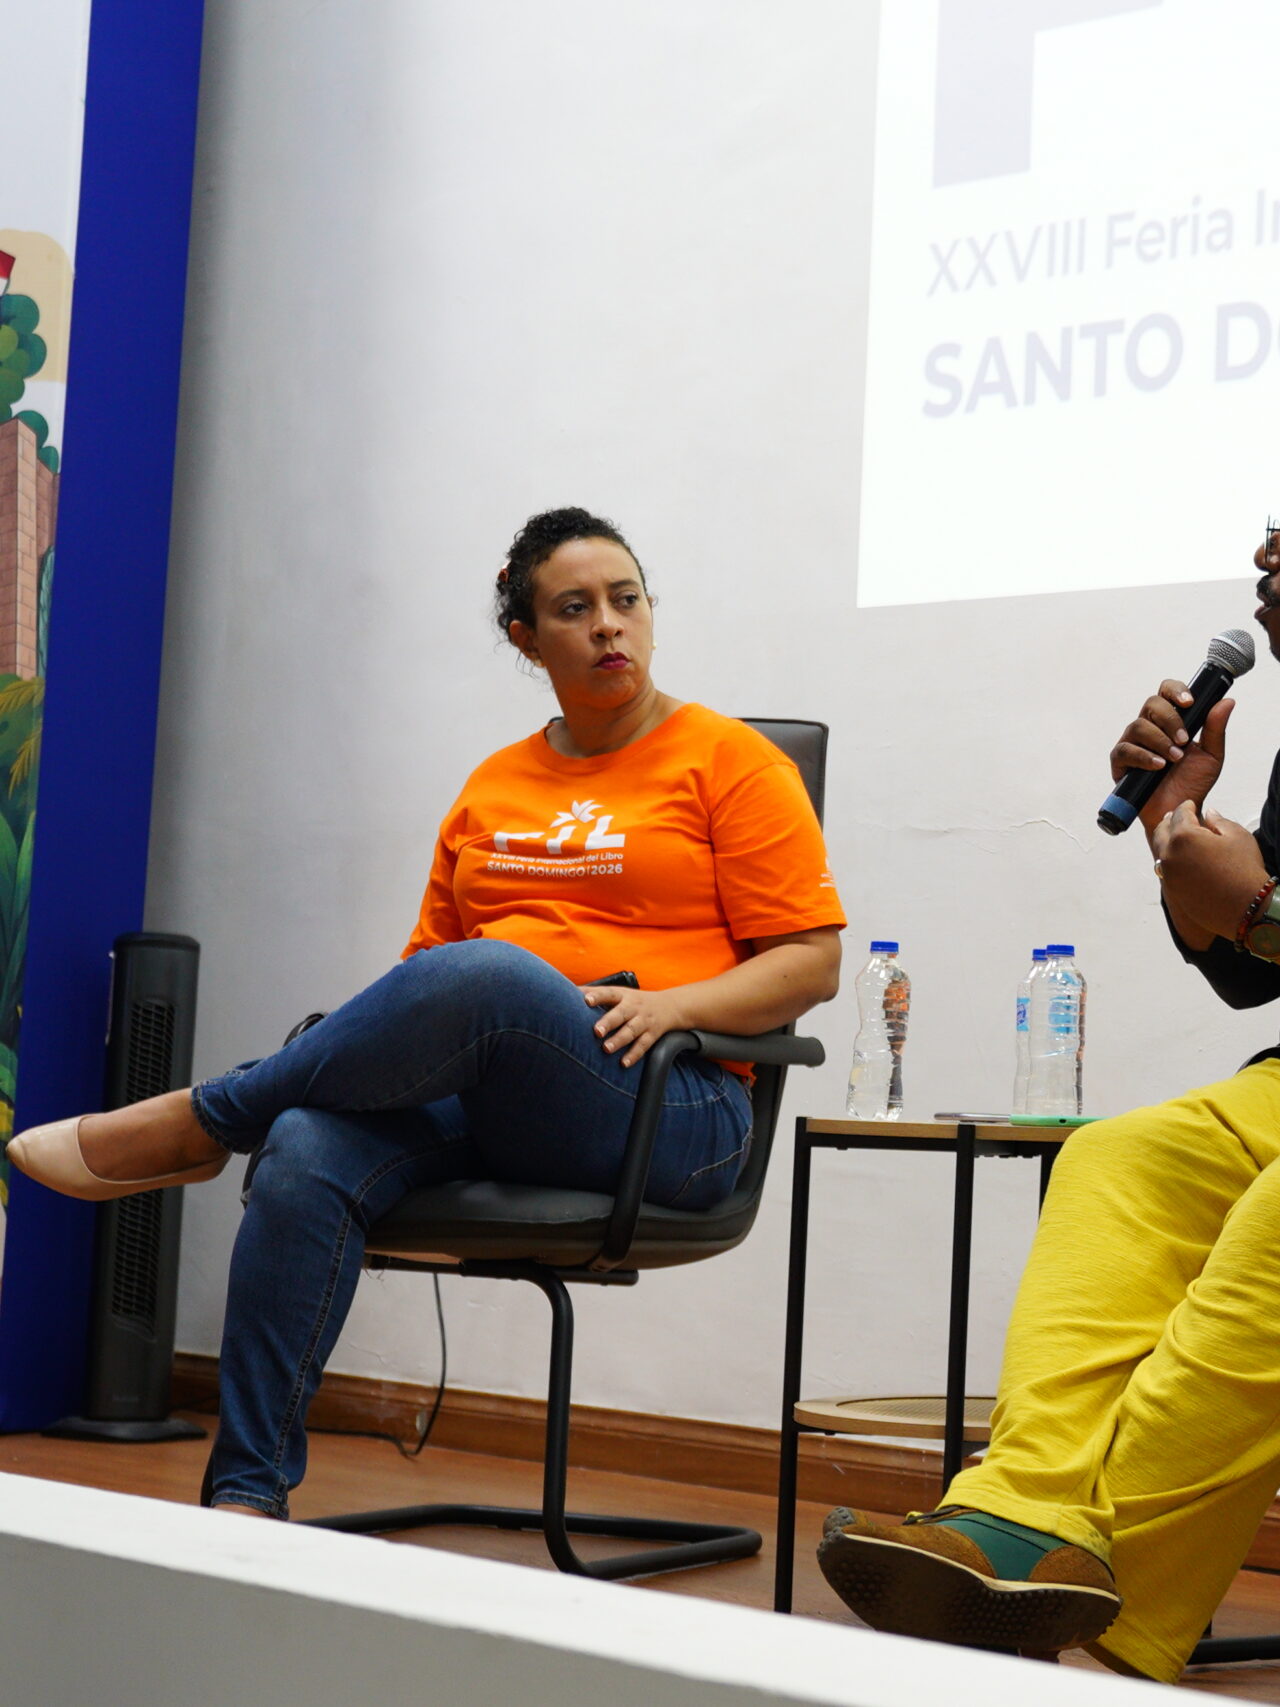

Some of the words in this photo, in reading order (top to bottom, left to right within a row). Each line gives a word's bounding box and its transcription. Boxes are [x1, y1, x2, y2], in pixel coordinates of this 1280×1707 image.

[928, 218, 1086, 296] XXVIII
[1105, 204, 1234, 269] Feria
[921, 312, 1185, 419] SANTO
[487, 860, 525, 874] SANTO
[528, 866, 585, 878] DOMINGO
[590, 863, 623, 875] 2026
[586, 853, 599, 862] del
[600, 851, 624, 861] Libro
